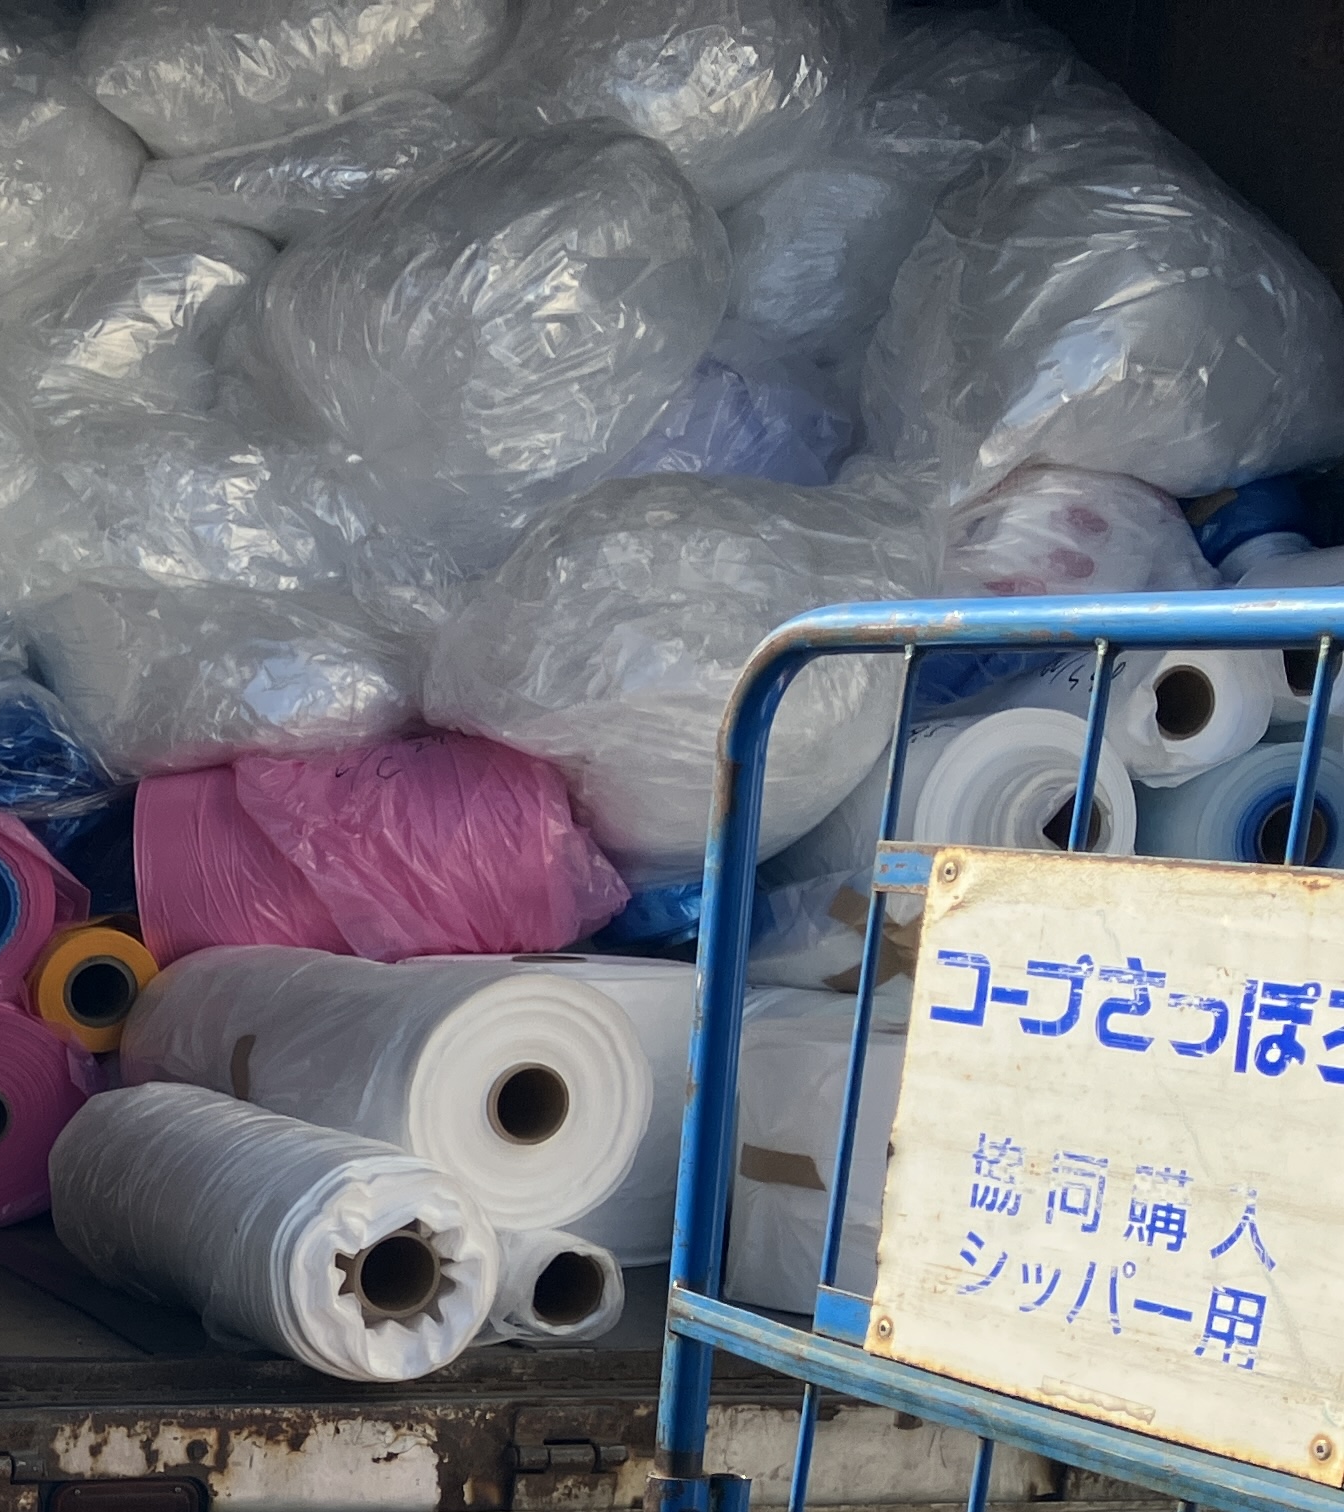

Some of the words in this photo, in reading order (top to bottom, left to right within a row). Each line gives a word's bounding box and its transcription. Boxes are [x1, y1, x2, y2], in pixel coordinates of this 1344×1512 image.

[969, 1132, 1276, 1272] 協同購入
[956, 1230, 1267, 1371] シッパー用
